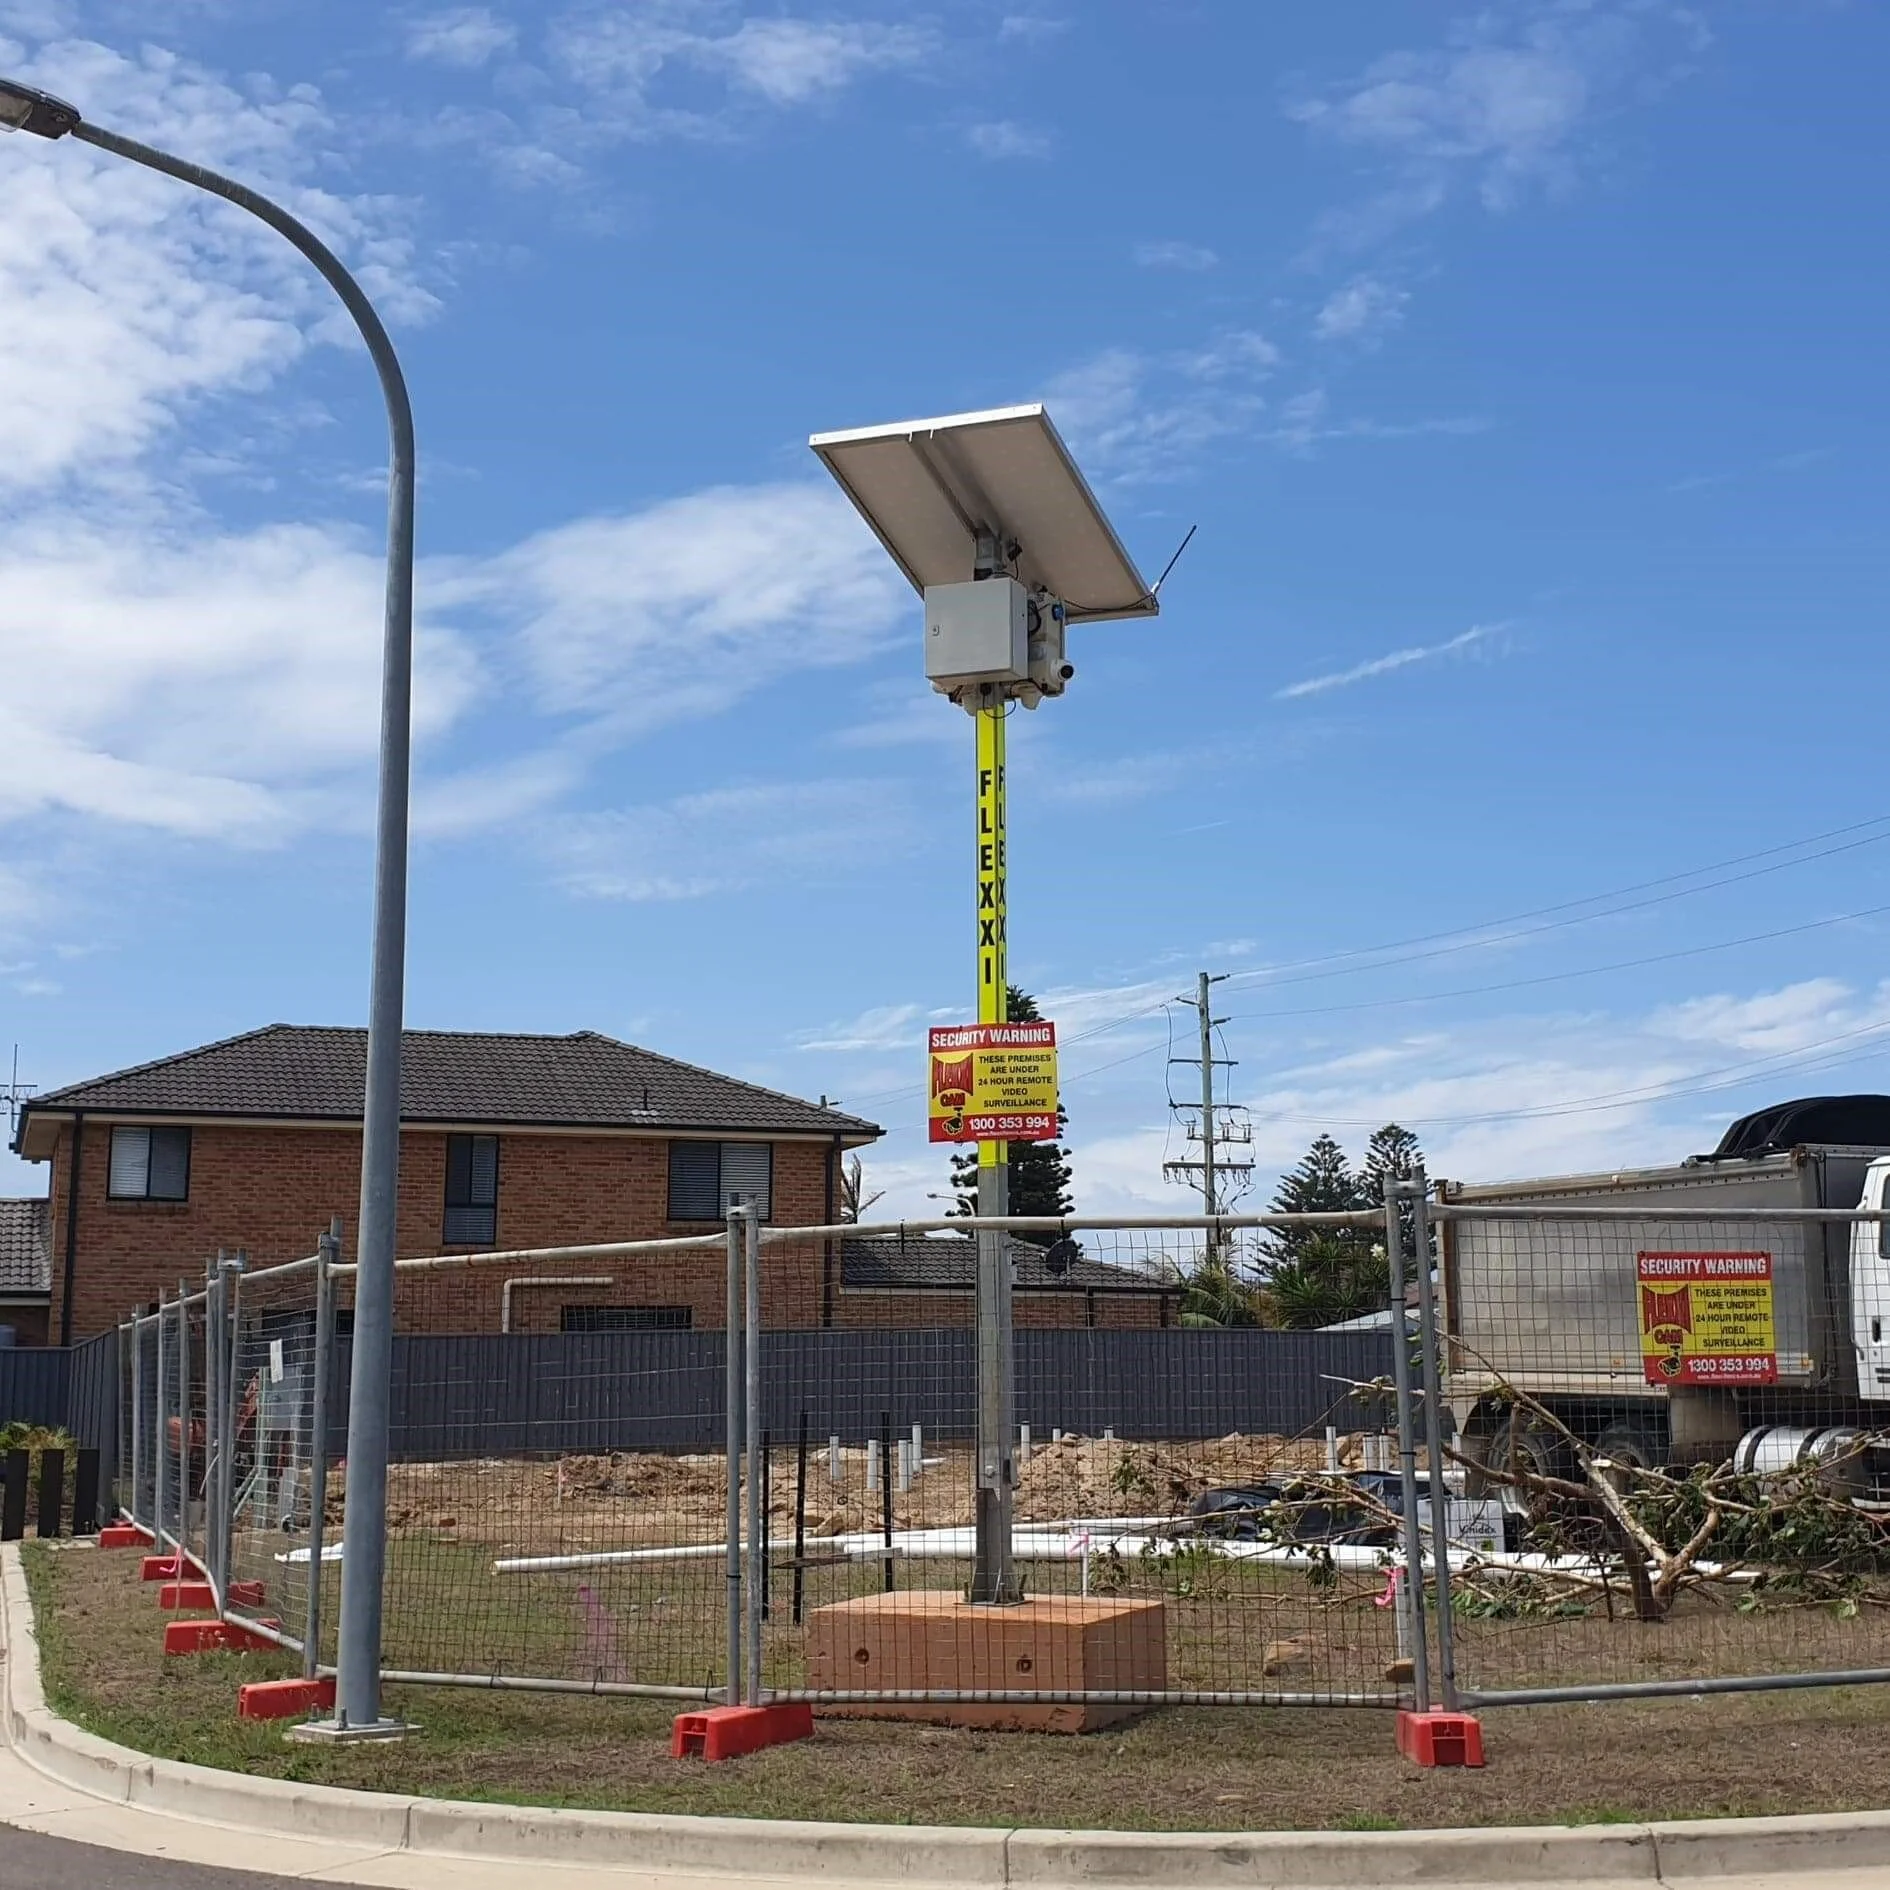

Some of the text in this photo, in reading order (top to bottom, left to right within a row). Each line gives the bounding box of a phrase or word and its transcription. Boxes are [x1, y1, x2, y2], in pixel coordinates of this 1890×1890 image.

[980, 770, 995, 984] FLEXXI
[932, 1028, 1050, 1047] SECURITY WARNING
[979, 1054, 1051, 1063] THESE PREMISES
[990, 1065, 1039, 1074] ARE UNDER
[978, 1076, 1052, 1086] 24 HOUR REMOTE
[1001, 1087, 1028, 1096] VIDEO
[983, 1098, 1047, 1108] SURVEILLANCE
[969, 1116, 1050, 1130] 1300 353 994
[1640, 1258, 1766, 1274] SECURITY WARNING
[1695, 1288, 1767, 1297] THESE PREMISES
[1707, 1301, 1756, 1309] ARE UNDER
[1695, 1313, 1769, 1322] 24 HOUR REMOTE
[1721, 1326, 1745, 1335] VIDEO
[1703, 1338, 1765, 1348] SURVEILLANCE
[1688, 1357, 1770, 1372] 1300 353 994
